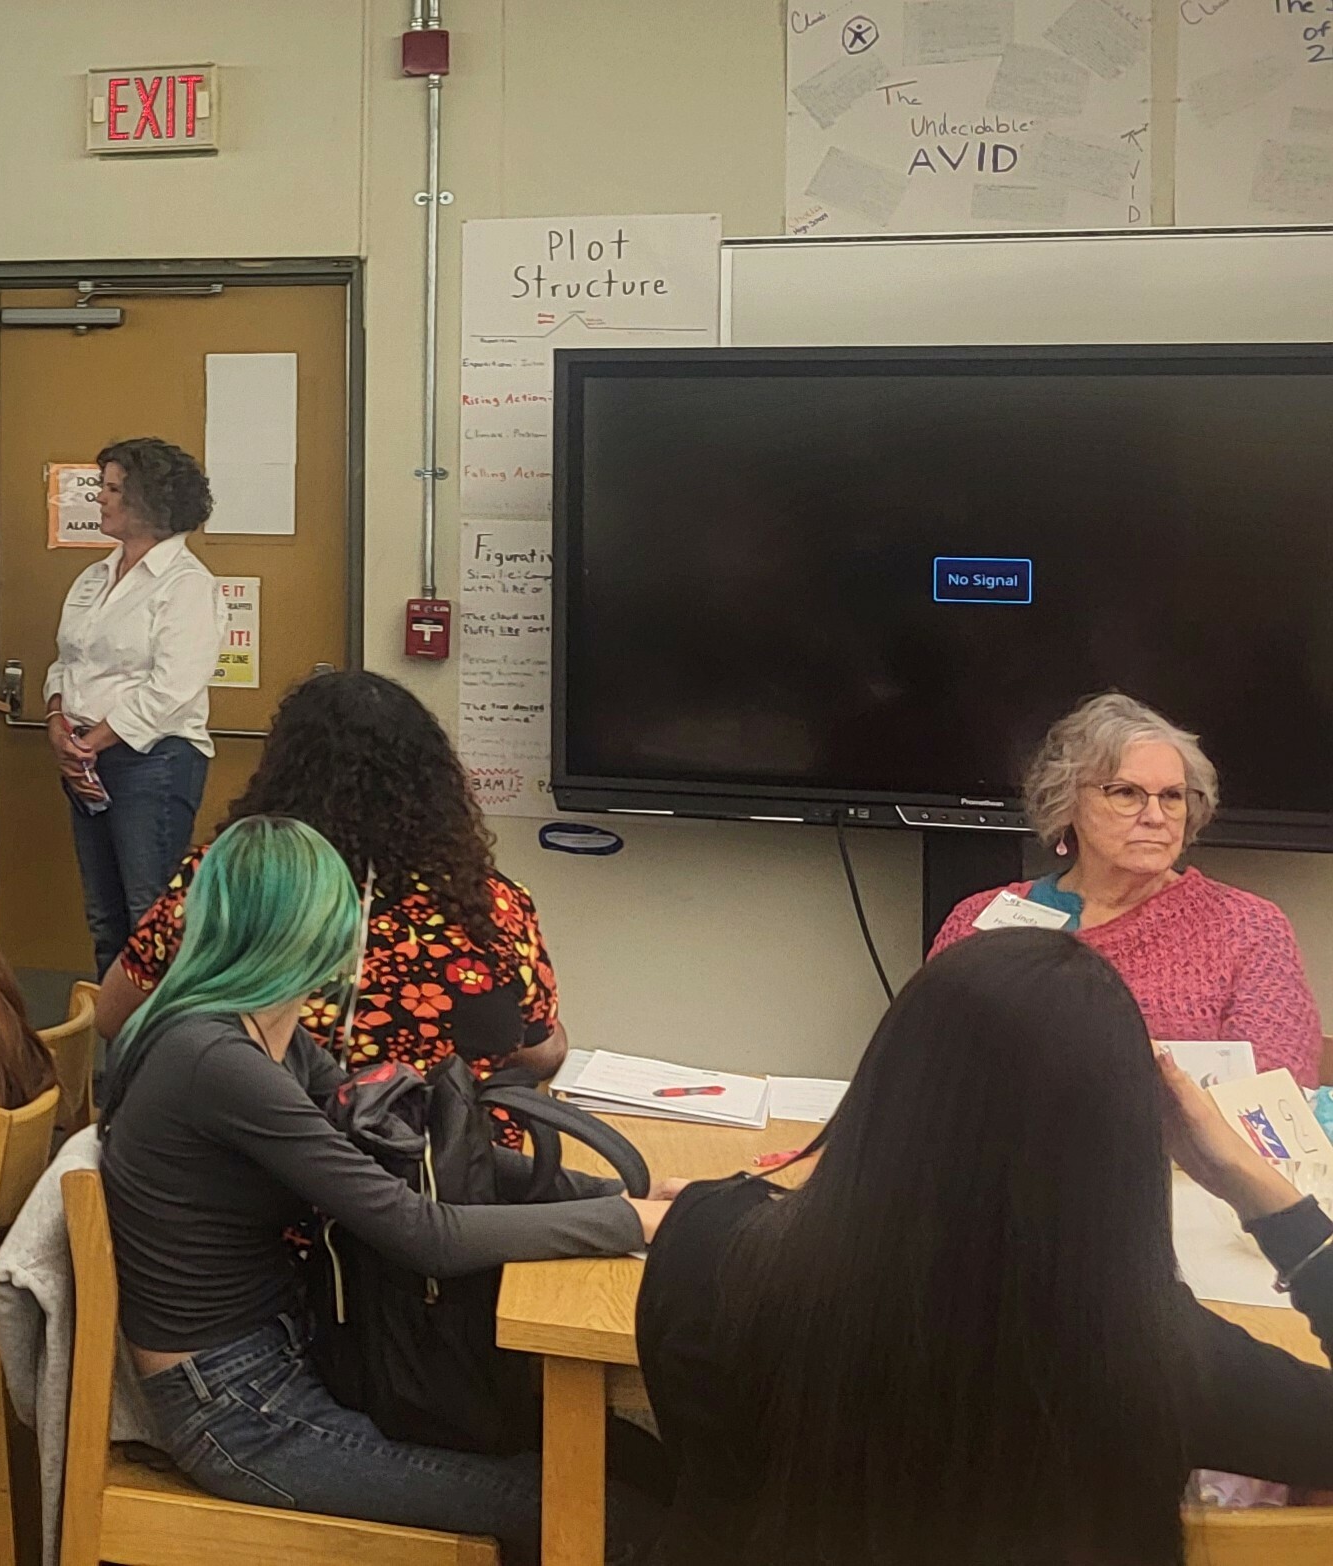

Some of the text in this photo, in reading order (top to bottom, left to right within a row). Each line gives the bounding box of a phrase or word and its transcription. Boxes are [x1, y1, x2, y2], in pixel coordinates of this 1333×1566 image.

[1303, 20, 1331, 41] of
[876, 80, 922, 105] The
[108, 75, 204, 140] EXIT
[908, 141, 1018, 176] AVID
[548, 228, 629, 261] Plot
[511, 264, 668, 298] Structure
[462, 395, 500, 407] Rising
[77, 476, 101, 487] DO
[464, 465, 507, 482] Falling
[948, 573, 1018, 589] No Signal
[234, 585, 245, 598] IT
[229, 630, 251, 647] IT!
